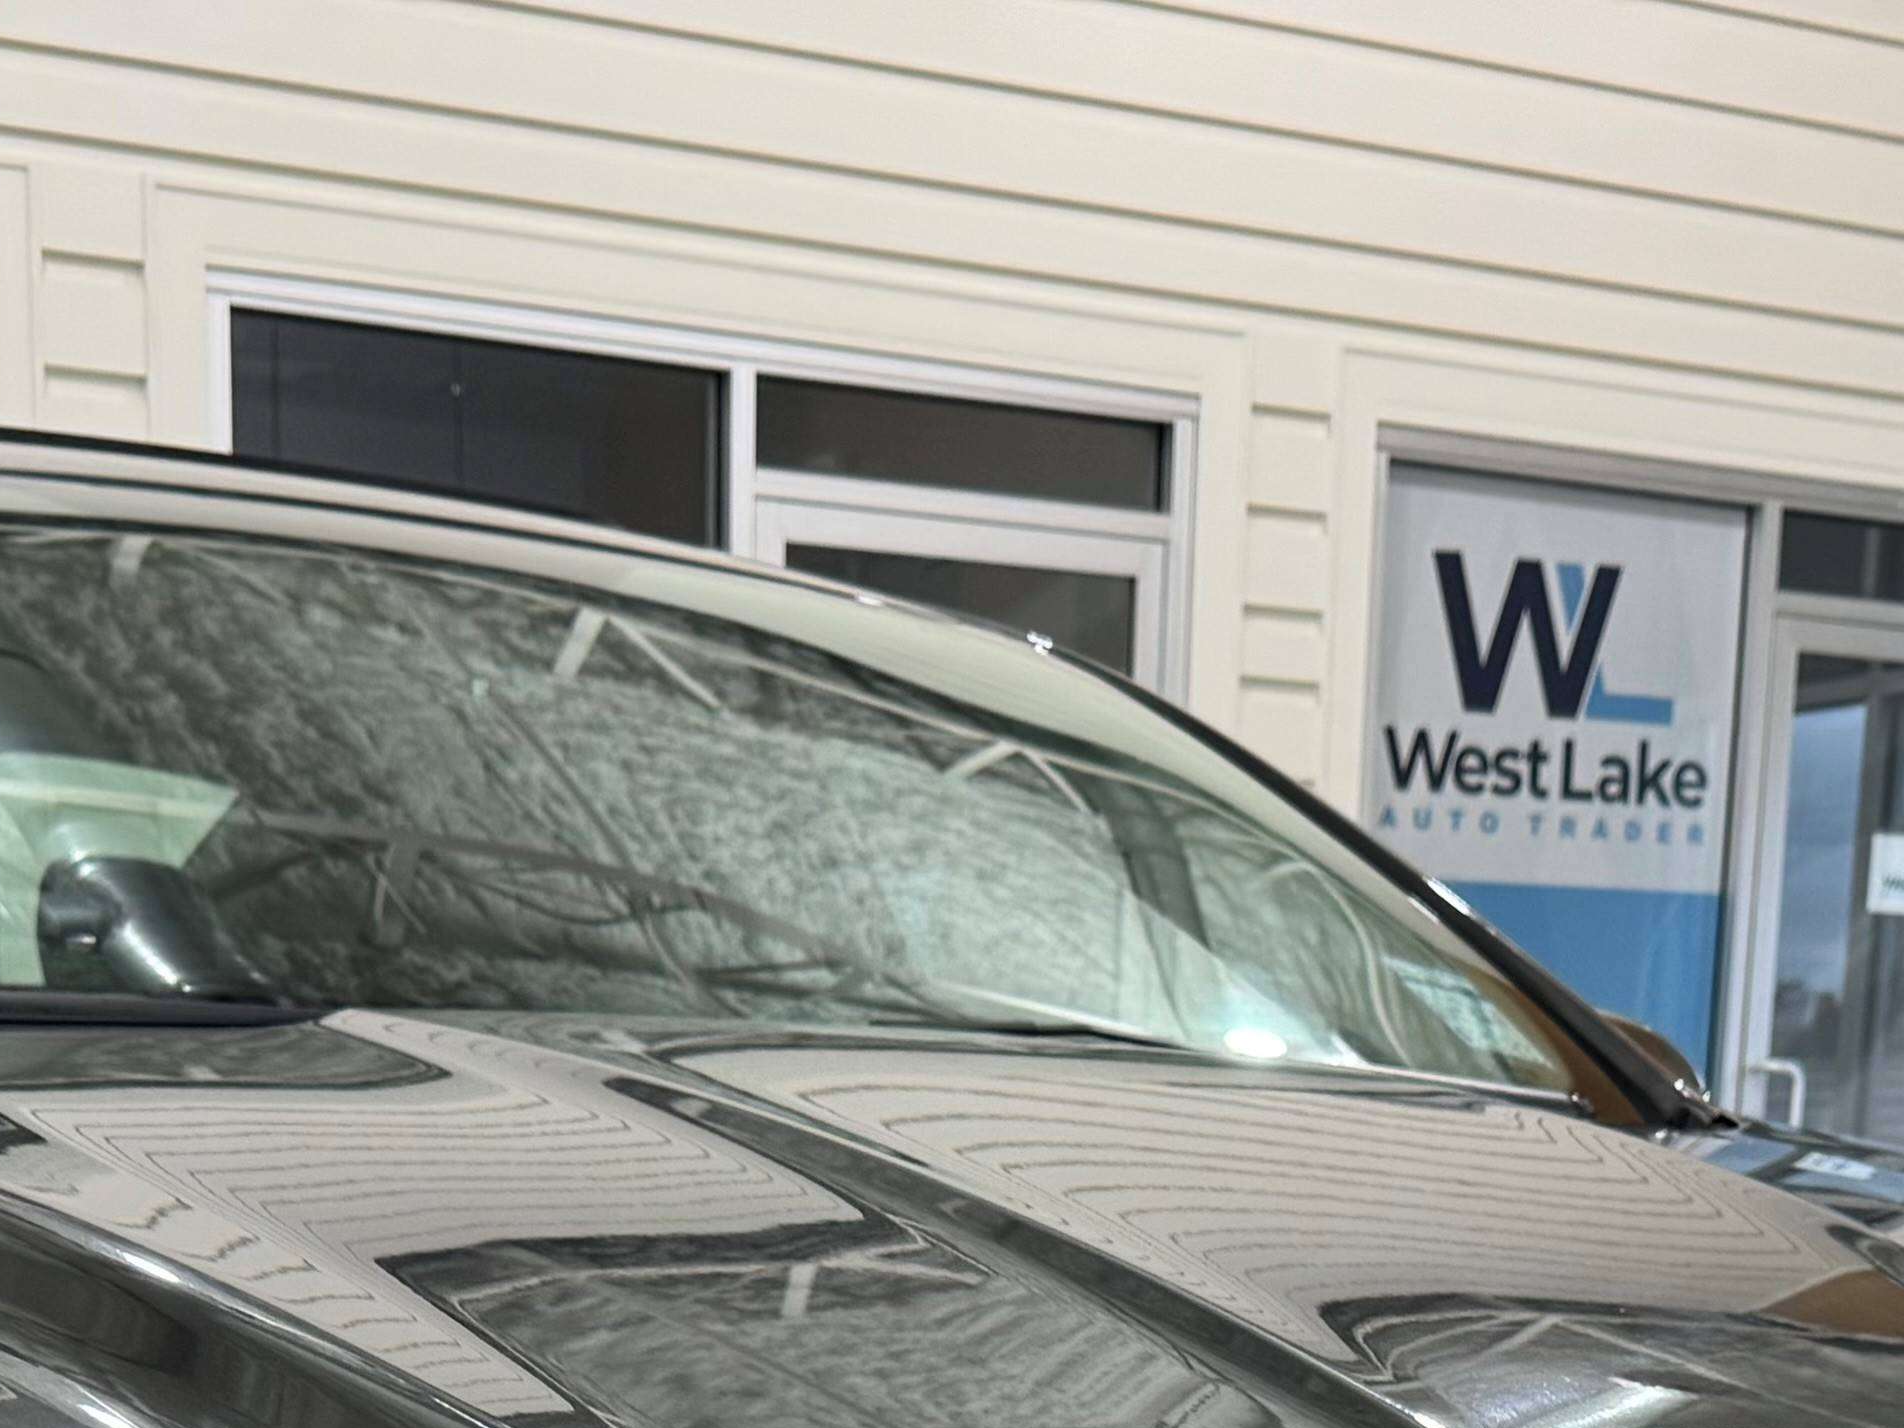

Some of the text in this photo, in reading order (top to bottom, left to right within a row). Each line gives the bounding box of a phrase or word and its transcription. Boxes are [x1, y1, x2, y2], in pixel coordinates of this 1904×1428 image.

[1383, 724, 1708, 808] West Lake
[1380, 803, 1704, 845] AUTO TRADER
